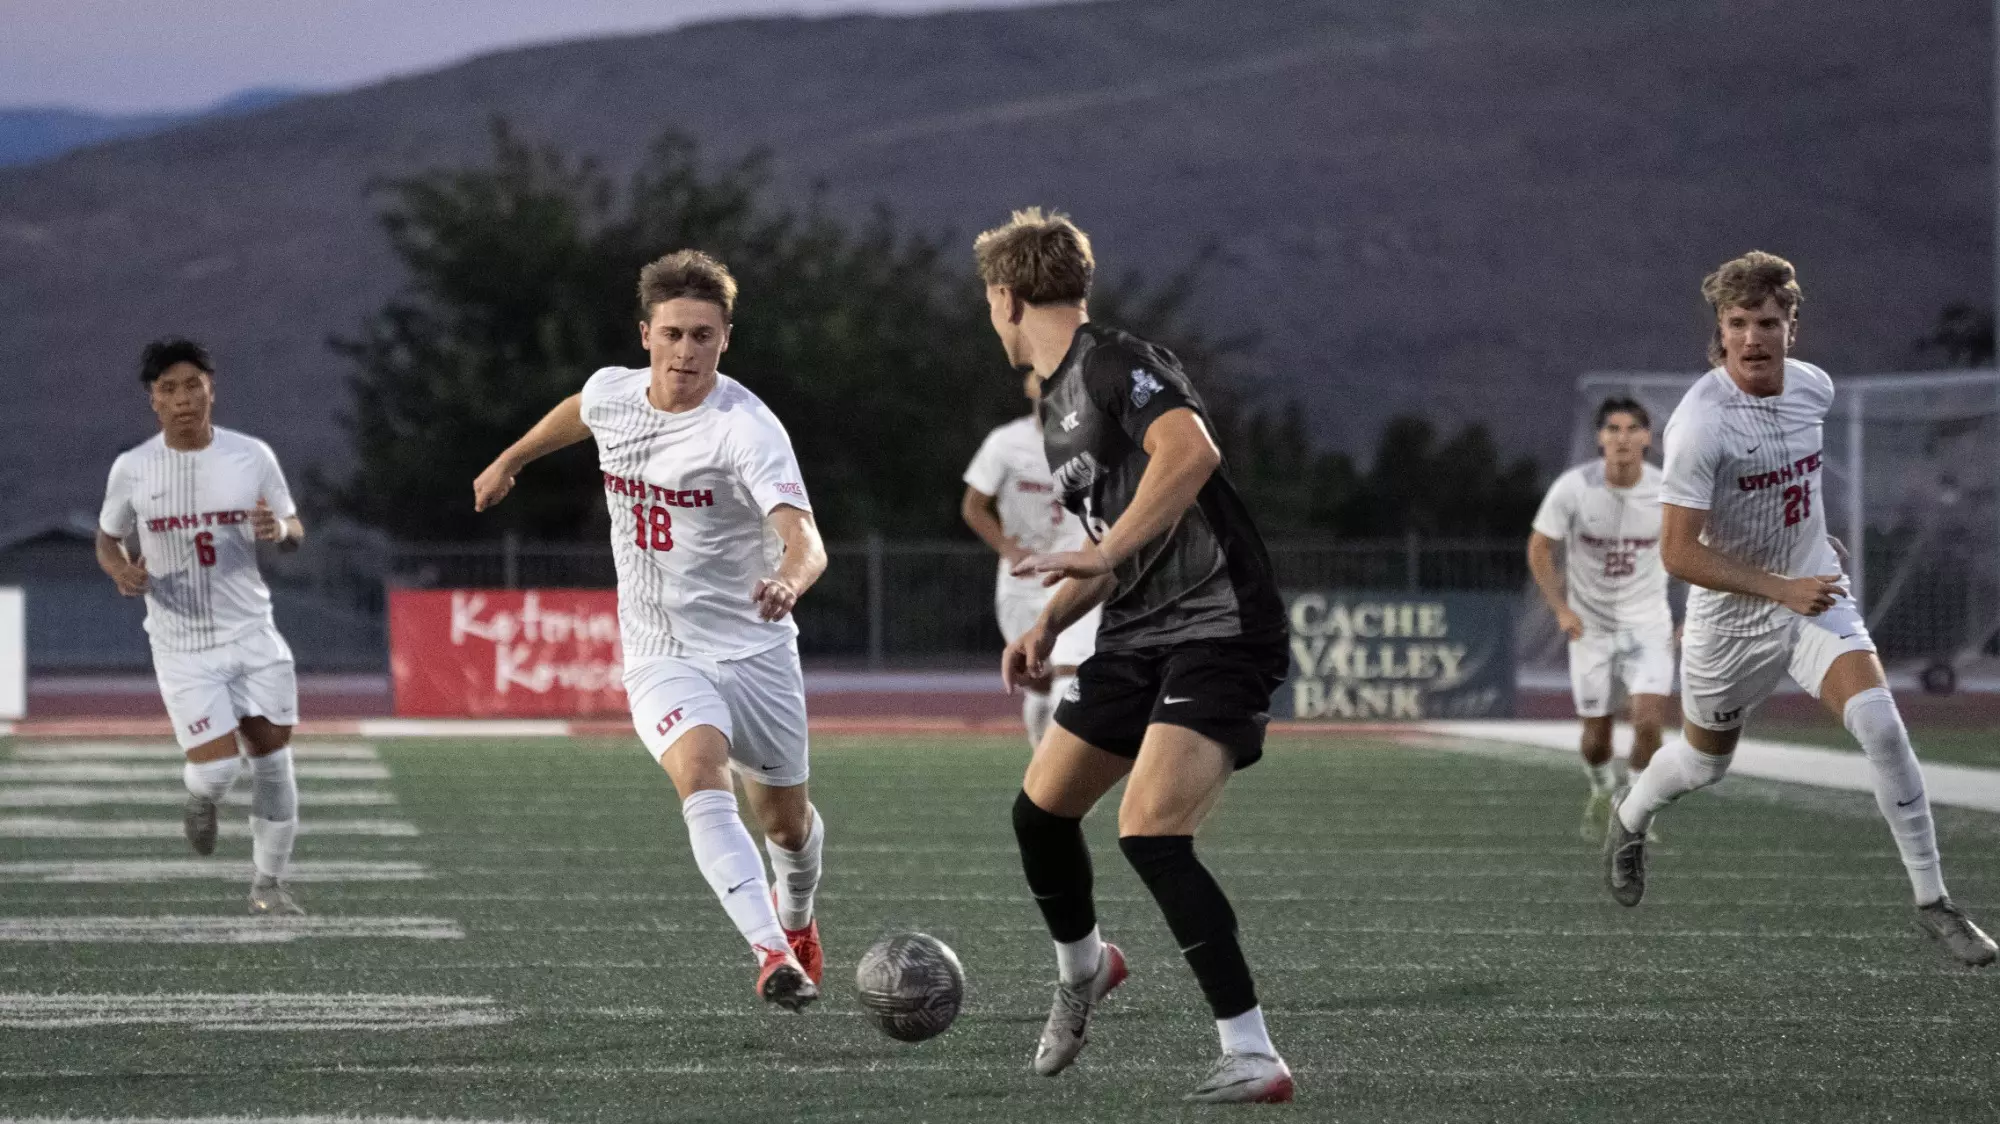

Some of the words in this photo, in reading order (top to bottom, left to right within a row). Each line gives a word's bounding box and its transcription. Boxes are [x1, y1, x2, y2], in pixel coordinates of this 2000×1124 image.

[603, 467, 646, 499] TAH
[649, 484, 714, 508] TECH
[1738, 463, 1792, 491] UTAH
[146, 513, 198, 532] UTAH
[202, 509, 249, 526] TEC
[1783, 479, 1811, 528] 21
[632, 503, 674, 552] 18
[194, 531, 217, 567] 6
[1290, 593, 1447, 637] CACHE
[1290, 636, 1466, 679] VALLEY
[1293, 677, 1420, 719] BANK
[1714, 706, 1742, 722] UT
[188, 716, 211, 735] UT
[656, 706, 683, 737] UT
